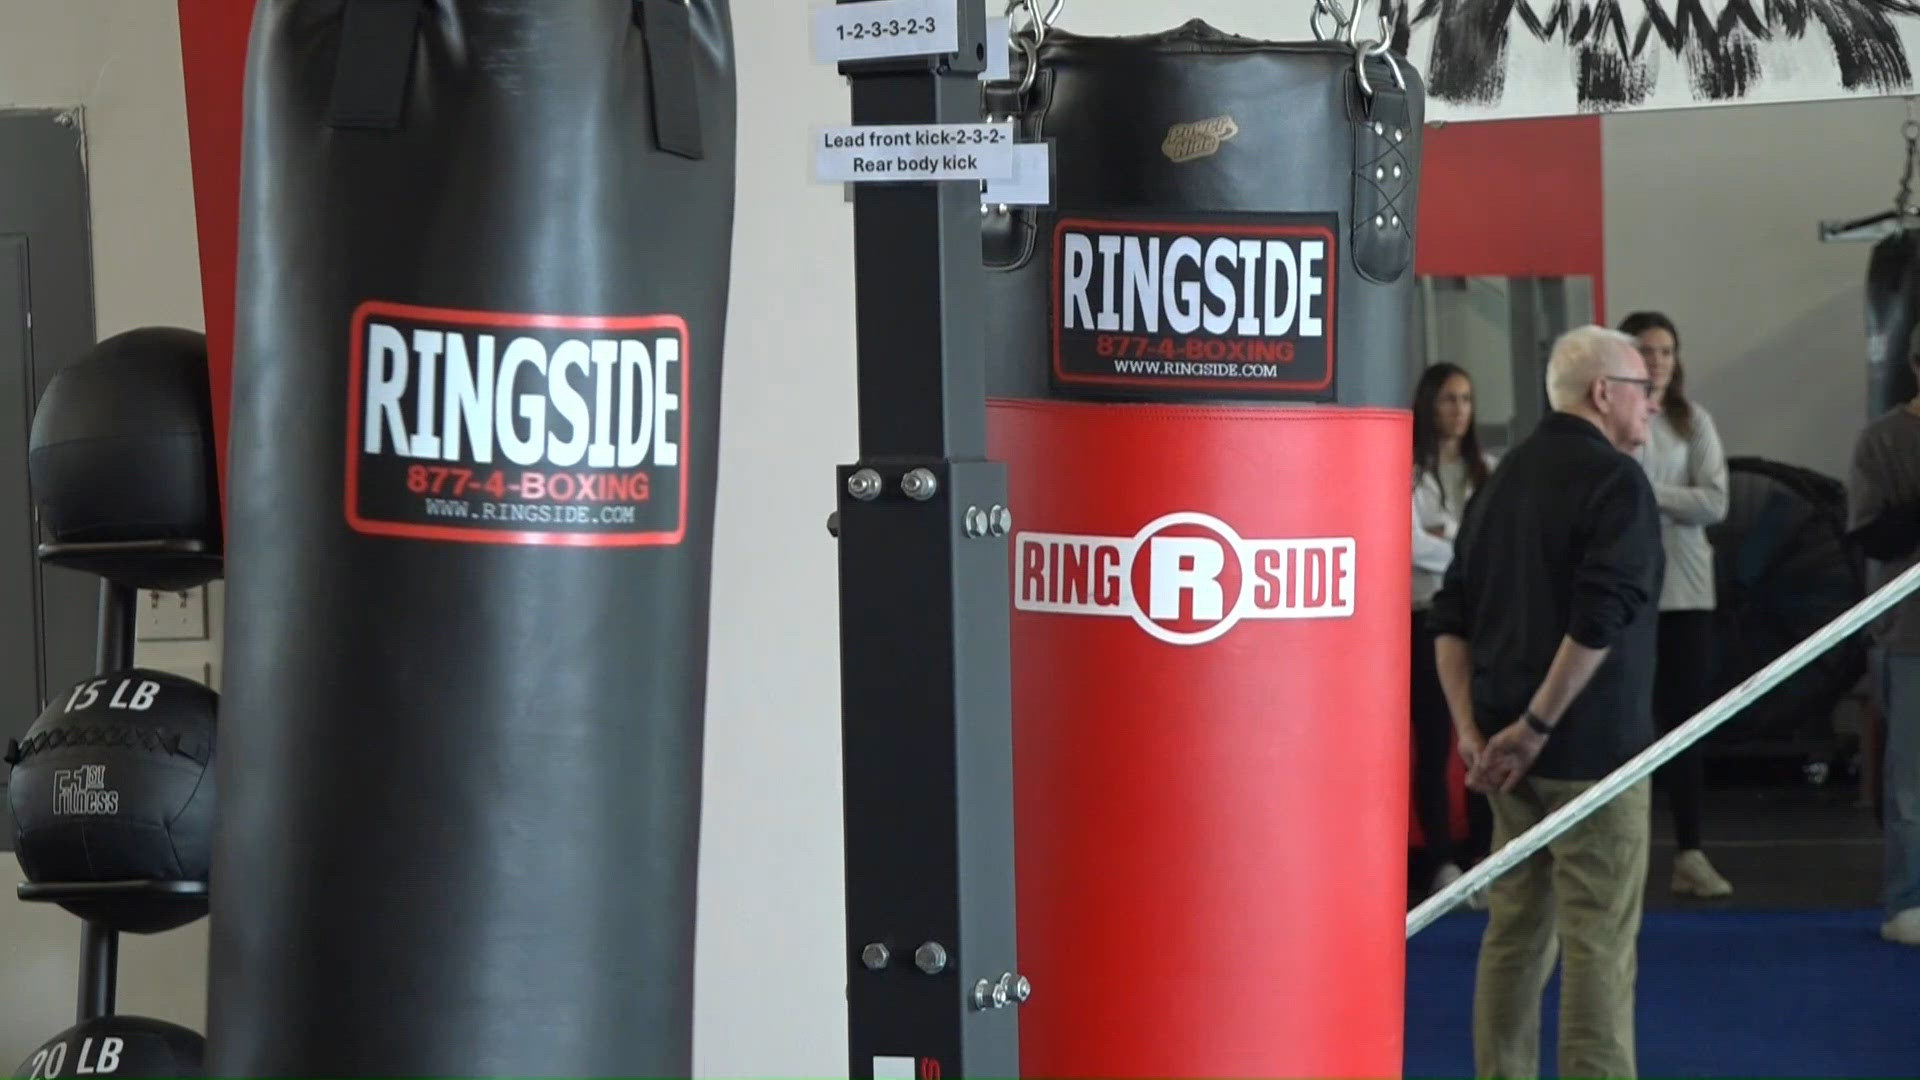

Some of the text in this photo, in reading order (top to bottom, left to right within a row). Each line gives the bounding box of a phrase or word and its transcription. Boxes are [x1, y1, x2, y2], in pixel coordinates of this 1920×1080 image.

[836, 17, 936, 41] 1-2-3-3-2-3
[824, 129, 1006, 148] Lead front kick-2-3-2-
[853, 155, 977, 176] Rear body kick
[1064, 232, 1324, 337] RINGSIDE
[1096, 336, 1296, 362] 877-4-BOXING
[1114, 359, 1278, 378] WWW.RINGSIDE.COM
[364, 323, 679, 468] RINGSIDE
[406, 465, 650, 500] 877-4-BOXING
[424, 498, 636, 524] WWW.RINGSIDE.COM
[1021, 536, 1348, 620] RING R SIDE
[64, 679, 160, 714] 15 LB
[52, 769, 120, 815] Fitness
[29, 1037, 124, 1080] 20 LB
